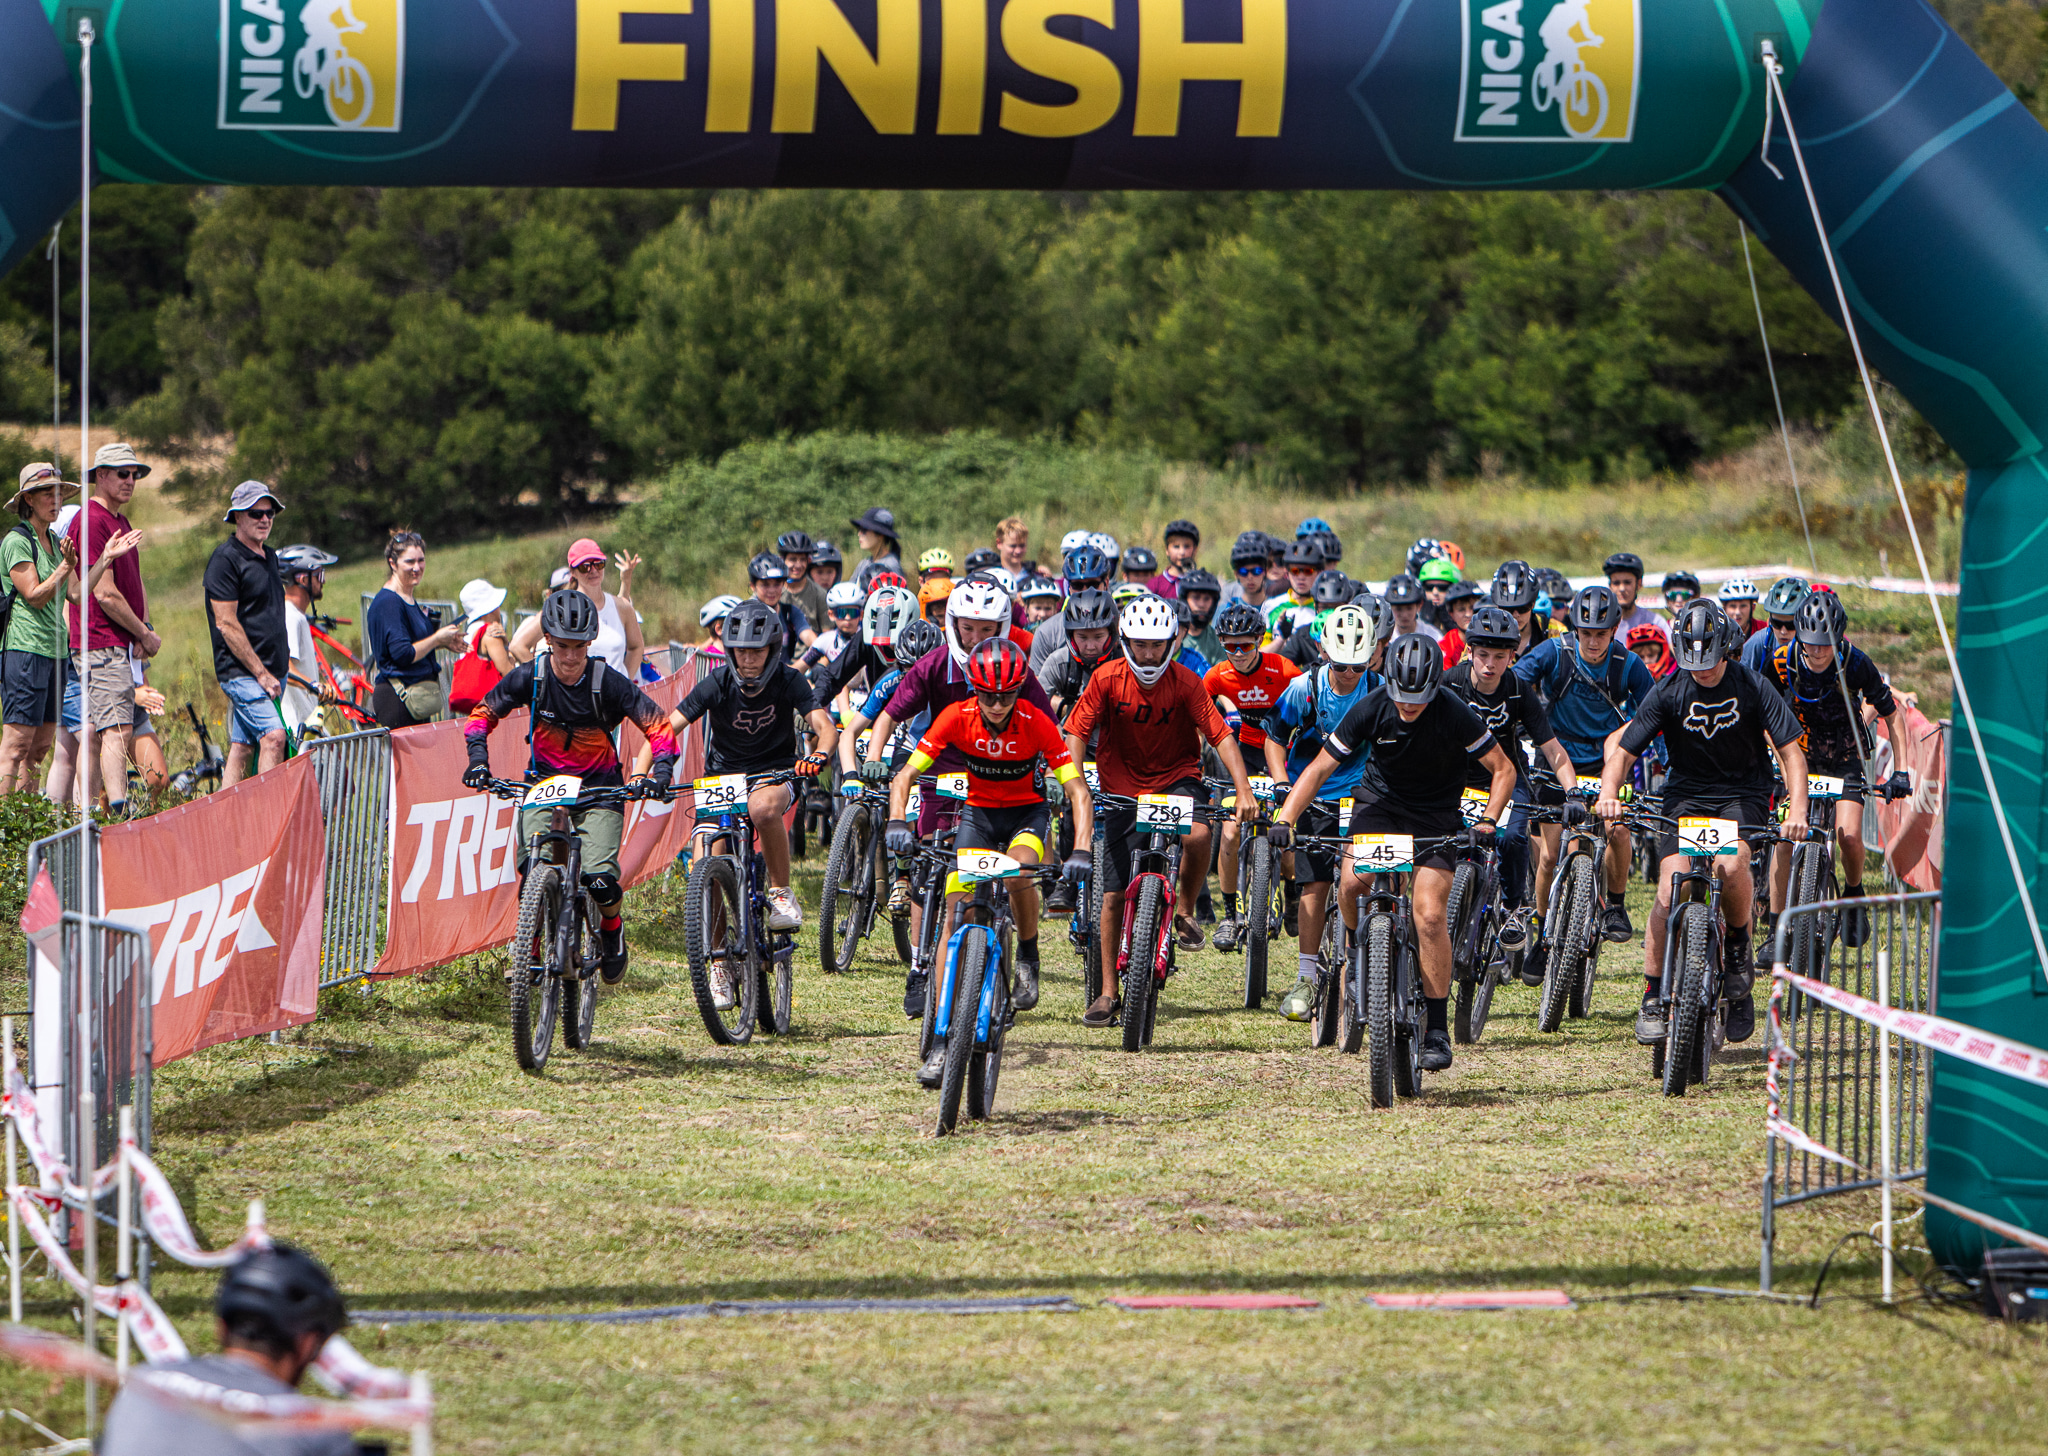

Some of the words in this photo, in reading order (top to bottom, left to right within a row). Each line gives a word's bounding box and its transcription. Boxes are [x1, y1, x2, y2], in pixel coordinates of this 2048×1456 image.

[239, 0, 285, 113] NICA
[1476, 0, 1524, 126] NICA
[571, 0, 1288, 138] FINISH
[1115, 701, 1175, 726] FOX
[975, 738, 1017, 757] CDC
[1002, 767, 1012, 775] &
[534, 783, 567, 800] 206
[953, 779, 969, 791] 8
[1582, 780, 1602, 790] 26
[705, 786, 736, 805] 258
[1148, 805, 1182, 823] 259
[1696, 828, 1720, 845] 43
[1372, 845, 1395, 862] 45
[978, 856, 1000, 870] 67
